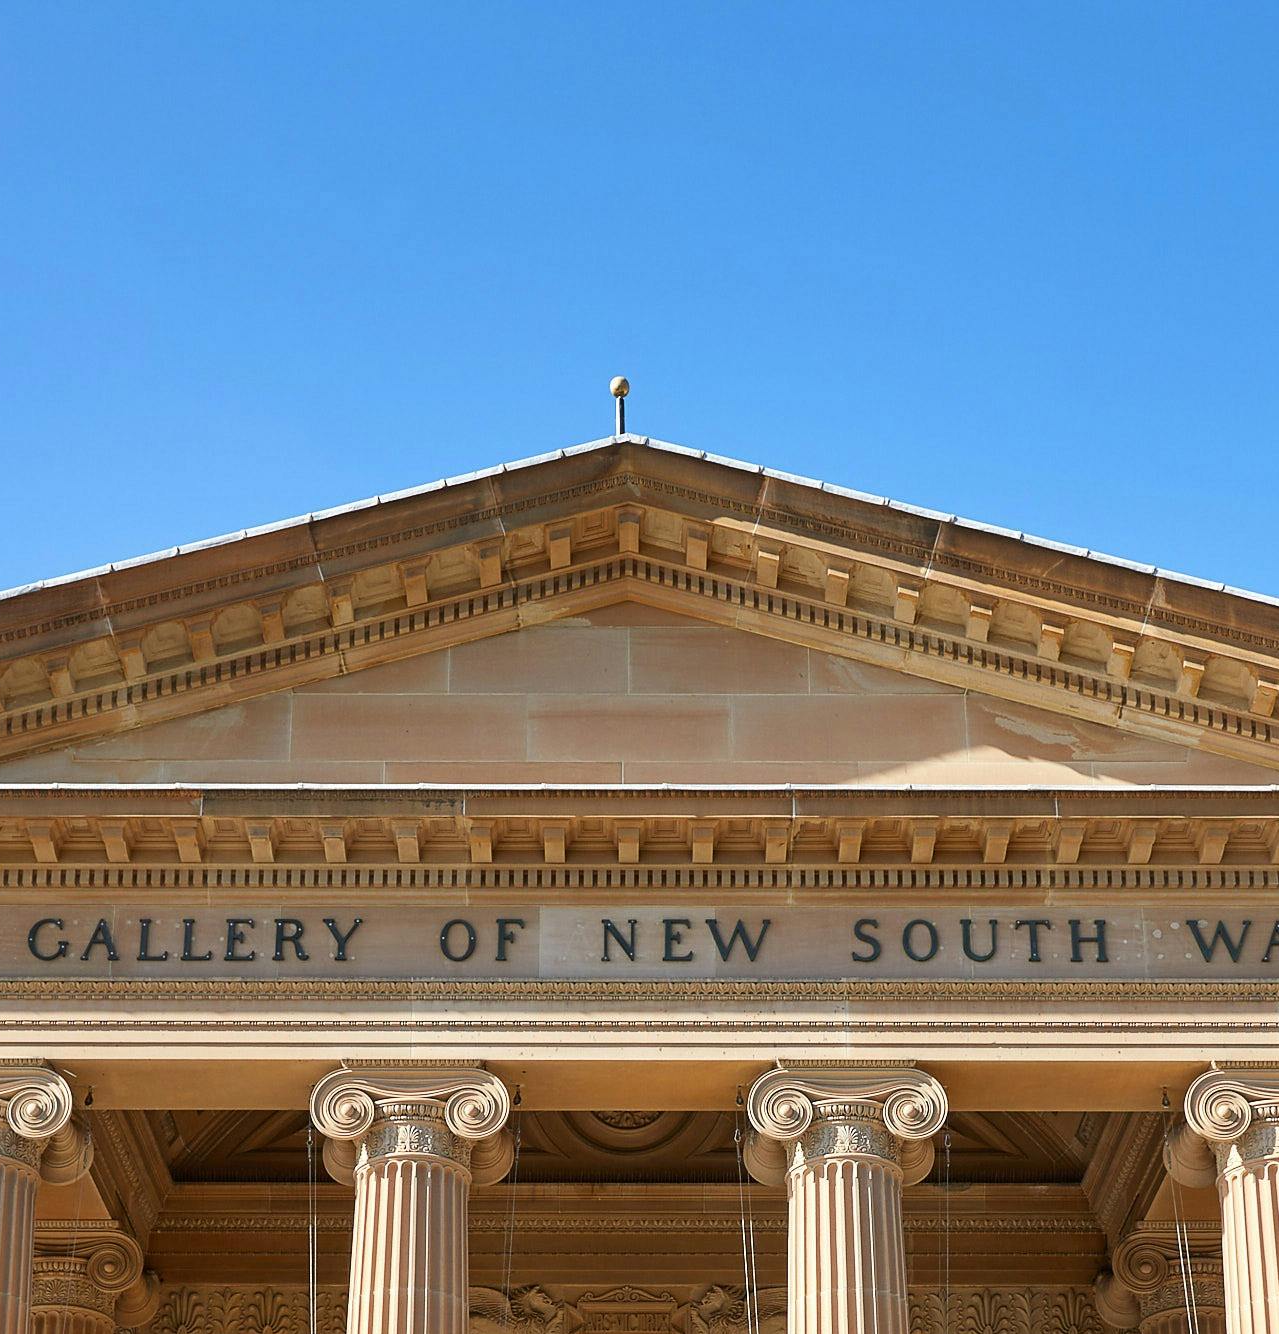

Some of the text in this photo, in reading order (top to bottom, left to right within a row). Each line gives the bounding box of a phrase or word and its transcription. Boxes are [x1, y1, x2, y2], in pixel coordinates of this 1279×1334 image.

[27, 918, 364, 962] GALLERY
[439, 918, 526, 963] OF
[600, 918, 772, 963] NEW
[851, 918, 1110, 963] SOUTH
